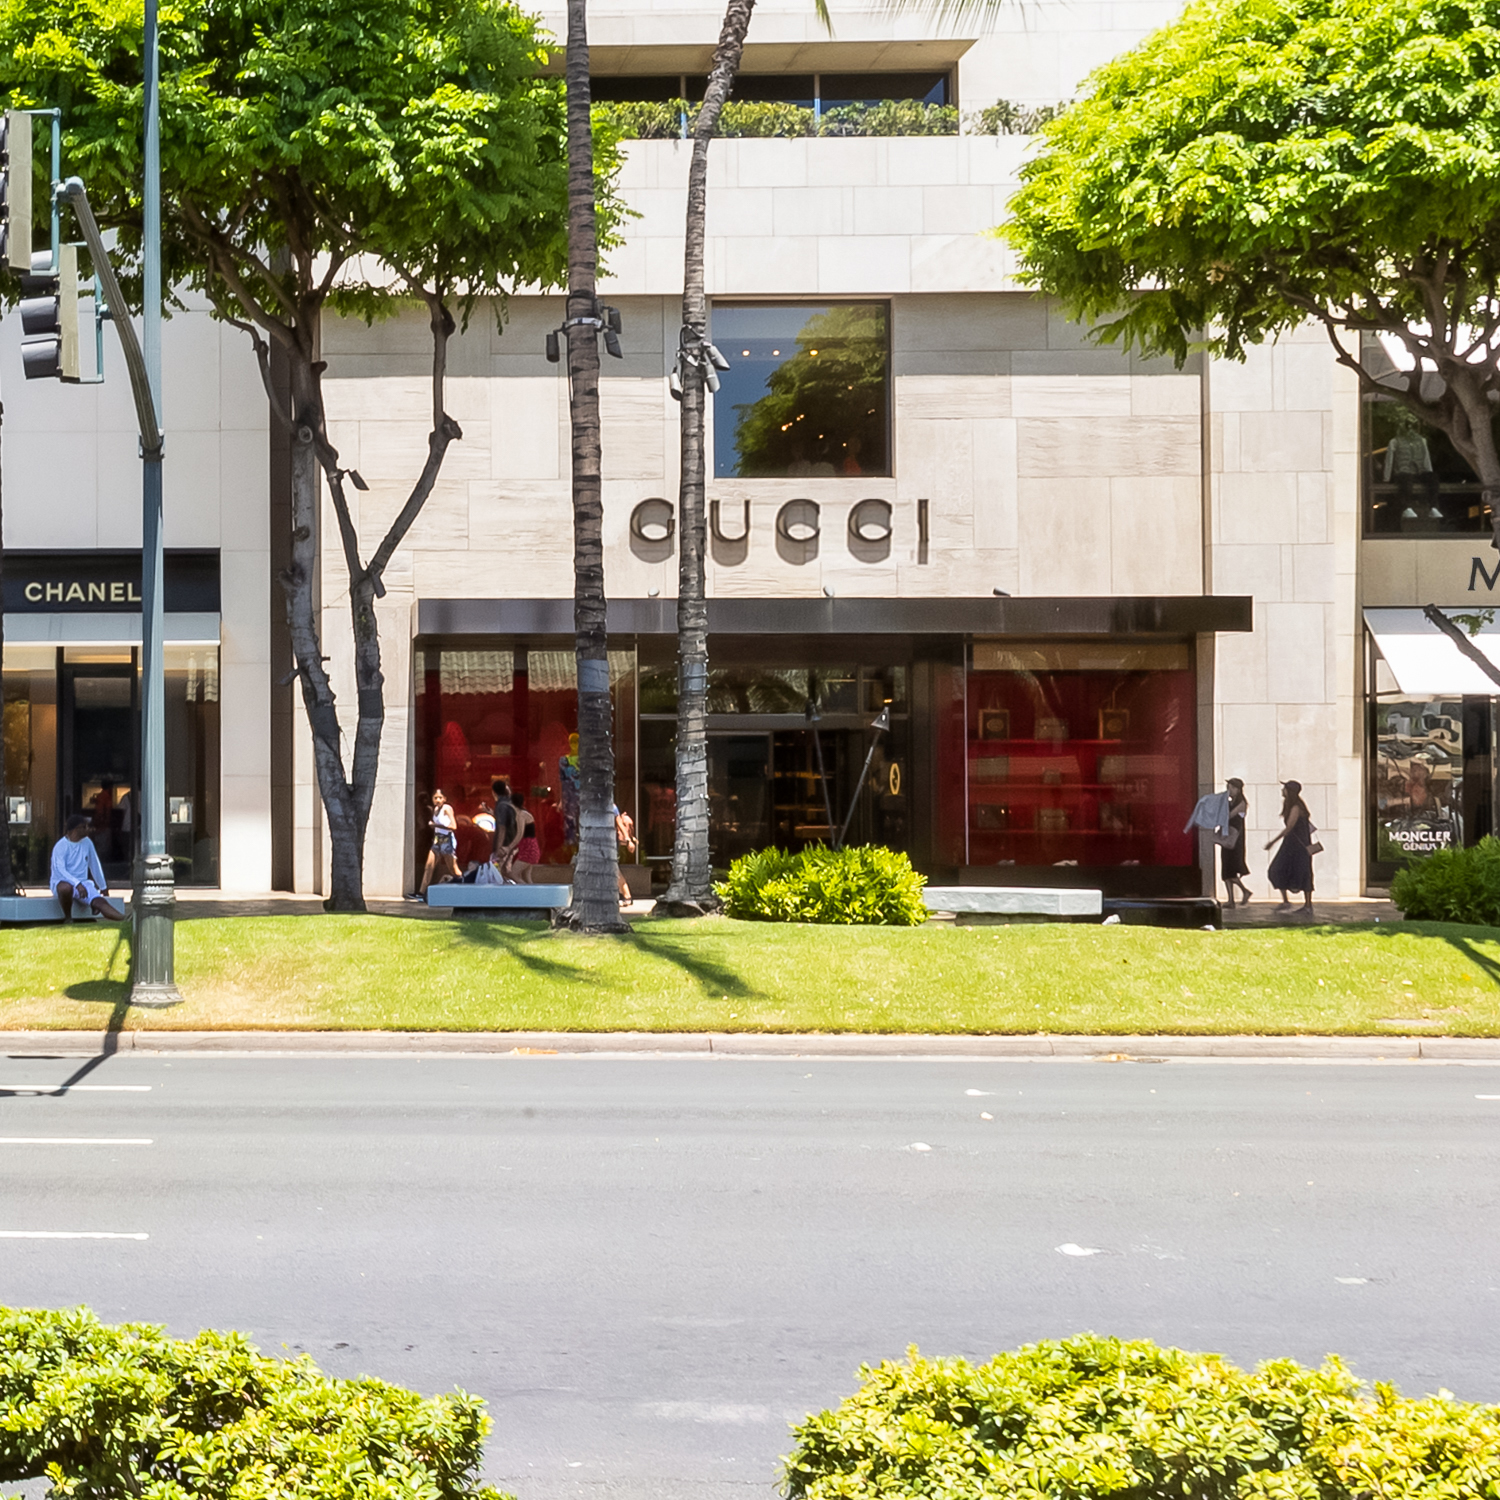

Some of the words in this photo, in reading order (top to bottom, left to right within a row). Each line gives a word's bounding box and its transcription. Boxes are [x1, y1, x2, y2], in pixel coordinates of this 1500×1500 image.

[629, 497, 930, 544] GUCCI
[24, 581, 142, 602] CHANEL
[1388, 830, 1452, 842] MONCLER
